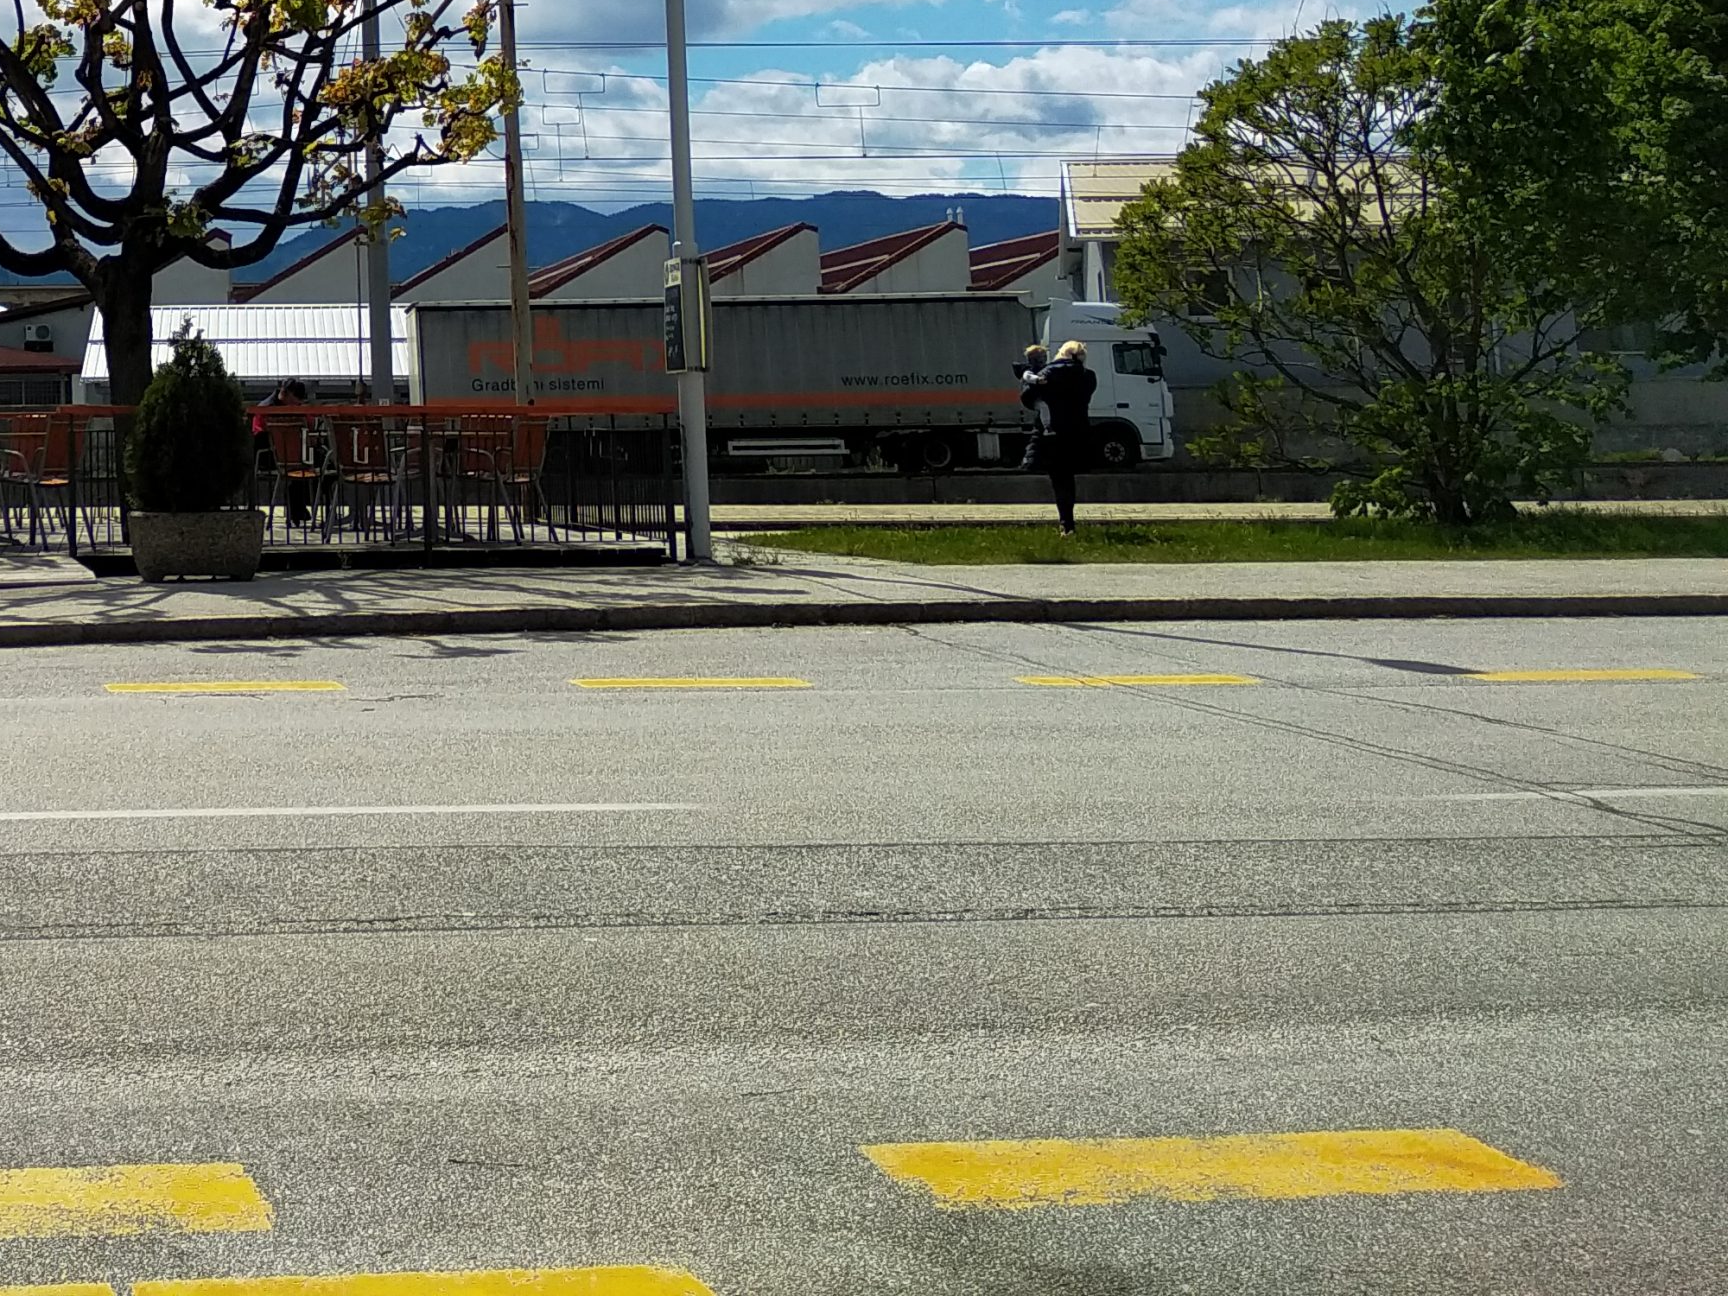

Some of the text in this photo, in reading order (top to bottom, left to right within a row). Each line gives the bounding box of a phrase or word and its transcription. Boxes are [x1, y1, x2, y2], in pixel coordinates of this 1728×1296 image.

[471, 377, 605, 392] Gradni sistemi
[840, 372, 969, 387] www.roefix.com
